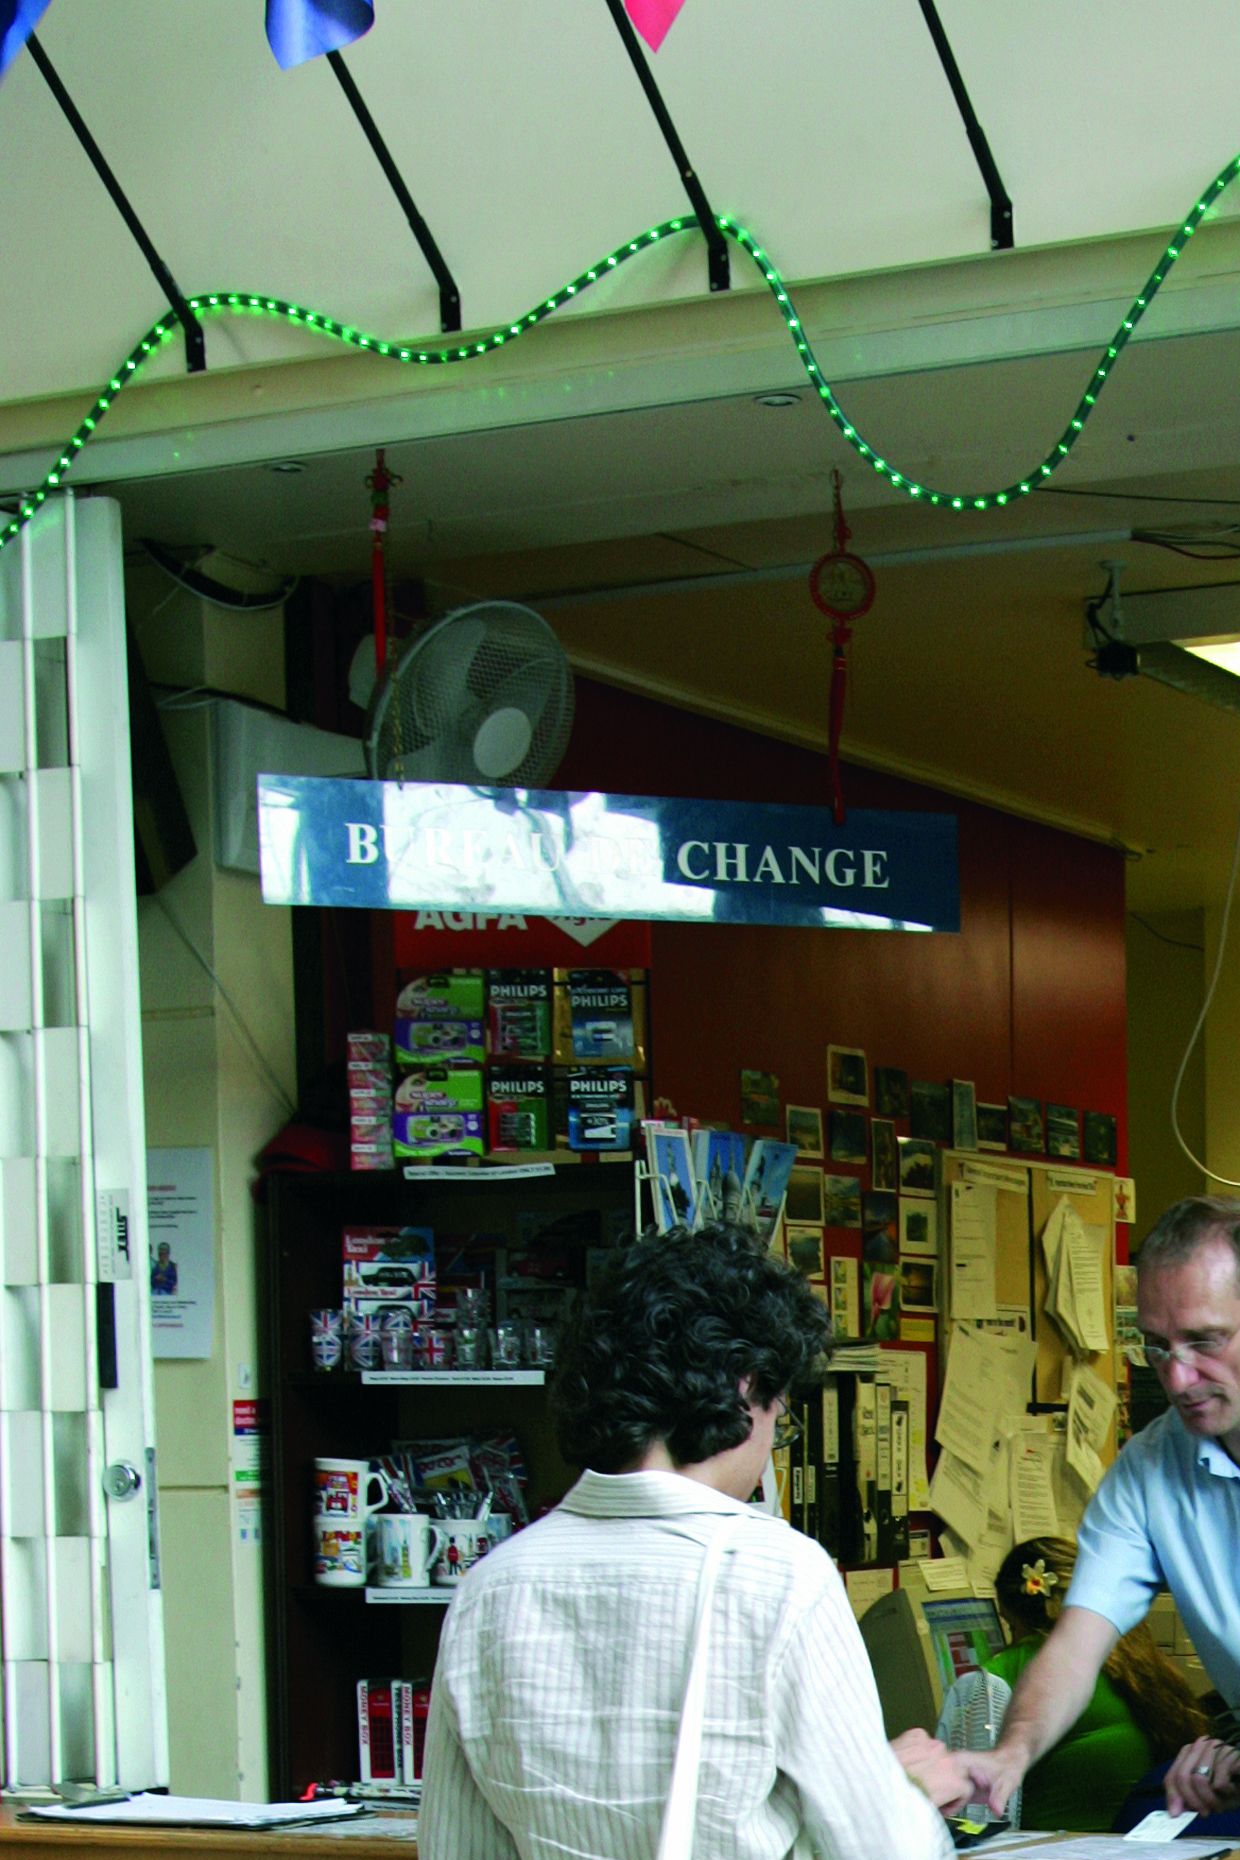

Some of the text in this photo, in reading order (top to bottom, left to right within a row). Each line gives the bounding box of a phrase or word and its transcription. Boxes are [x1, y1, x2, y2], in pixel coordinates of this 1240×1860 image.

[346, 822, 561, 874] BUREAU
[676, 839, 891, 890] CHANGE
[413, 910, 528, 931] AGFA
[490, 983, 547, 999] PHILIPS
[571, 993, 629, 1008] PHILIPS
[490, 1079, 545, 1094] PHILIPS
[570, 1079, 628, 1094] PHILIPS
